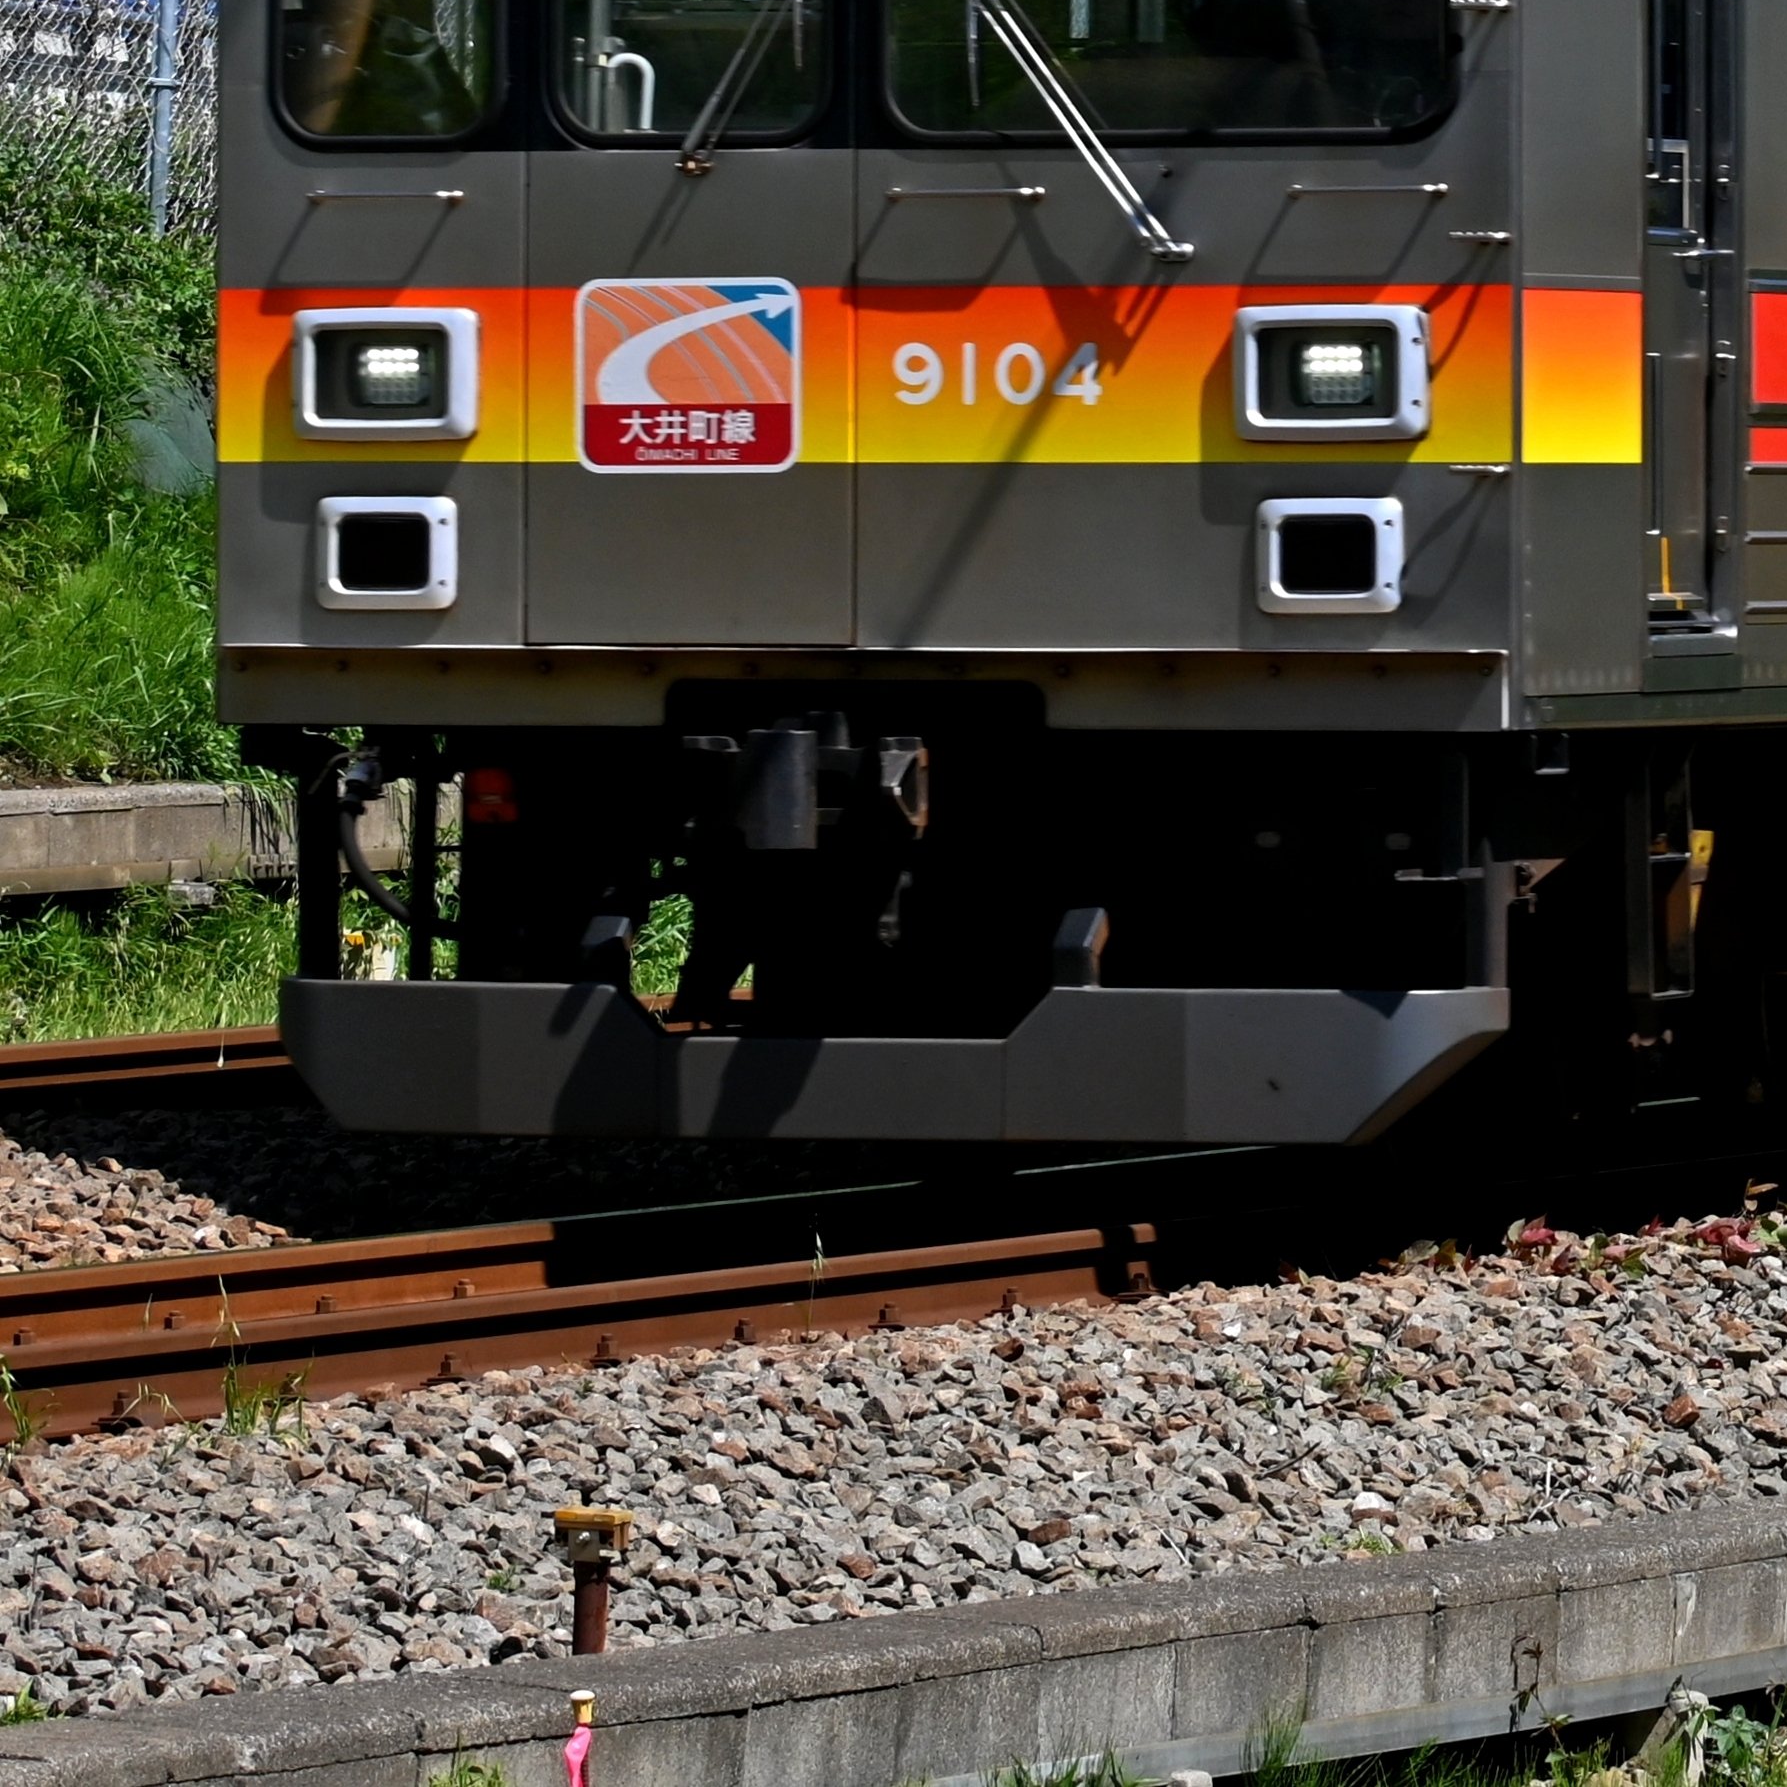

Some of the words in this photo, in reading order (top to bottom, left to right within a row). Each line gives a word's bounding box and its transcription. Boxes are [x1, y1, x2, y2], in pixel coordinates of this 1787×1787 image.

[892, 342, 1103, 405] 9104
[619, 409, 756, 444] 大井町線
